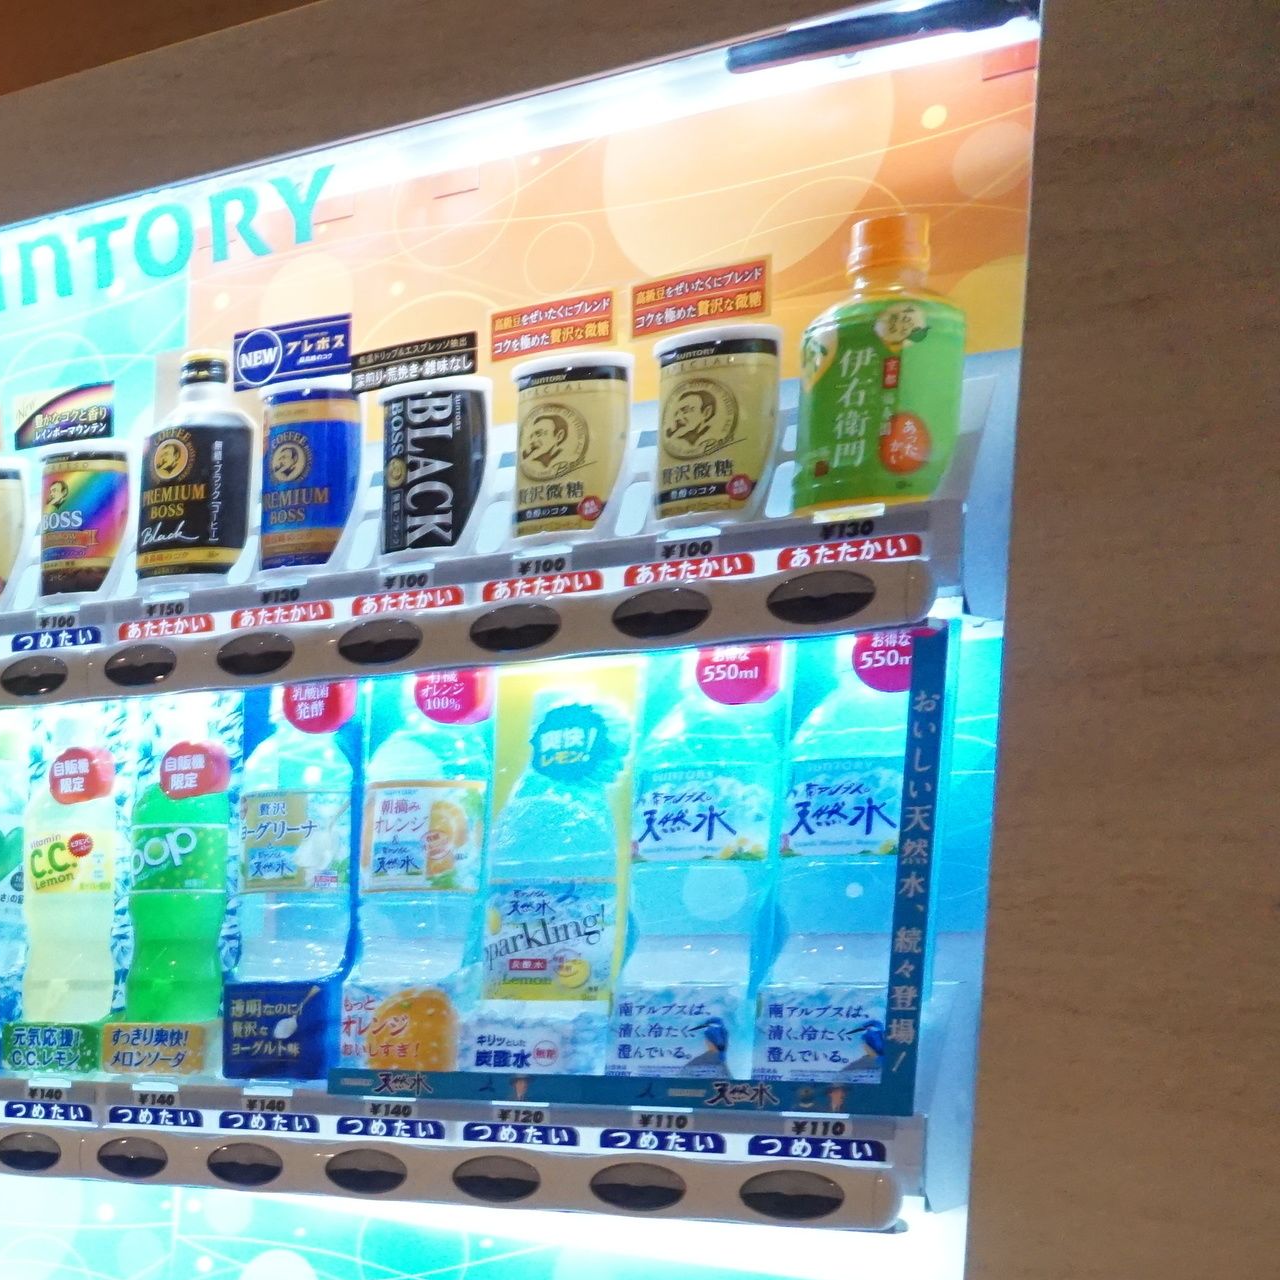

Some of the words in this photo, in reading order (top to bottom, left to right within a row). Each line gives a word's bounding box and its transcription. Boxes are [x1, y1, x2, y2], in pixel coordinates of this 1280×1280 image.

[240, 348, 278, 369] NEW
[833, 348, 878, 468] 伊右衛門
[407, 394, 454, 544] BLACK
[150, 504, 184, 520] BOSS
[270, 506, 306, 523] BOSS
[141, 521, 200, 546] Black
[790, 536, 909, 568] あたたかい
[636, 556, 742, 584] あたたかい
[494, 571, 593, 600] あたたかい
[361, 589, 453, 614] あたたかい
[240, 603, 325, 627] あたたかい
[128, 616, 206, 639] あたたかい
[701, 663, 760, 682] 550ml
[638, 803, 737, 843] 天然水
[788, 801, 898, 839] 天然水
[342, 1015, 411, 1037] オレンジ
[12, 1028, 80, 1048] 元気応援!
[112, 1028, 188, 1047] すっきり爽快!
[12, 1050, 80, 1067] C.C.レモン
[112, 1052, 186, 1067] メロンソーダ
[475, 1050, 532, 1068] 炭酸水
[759, 1137, 874, 1159] つめたい
